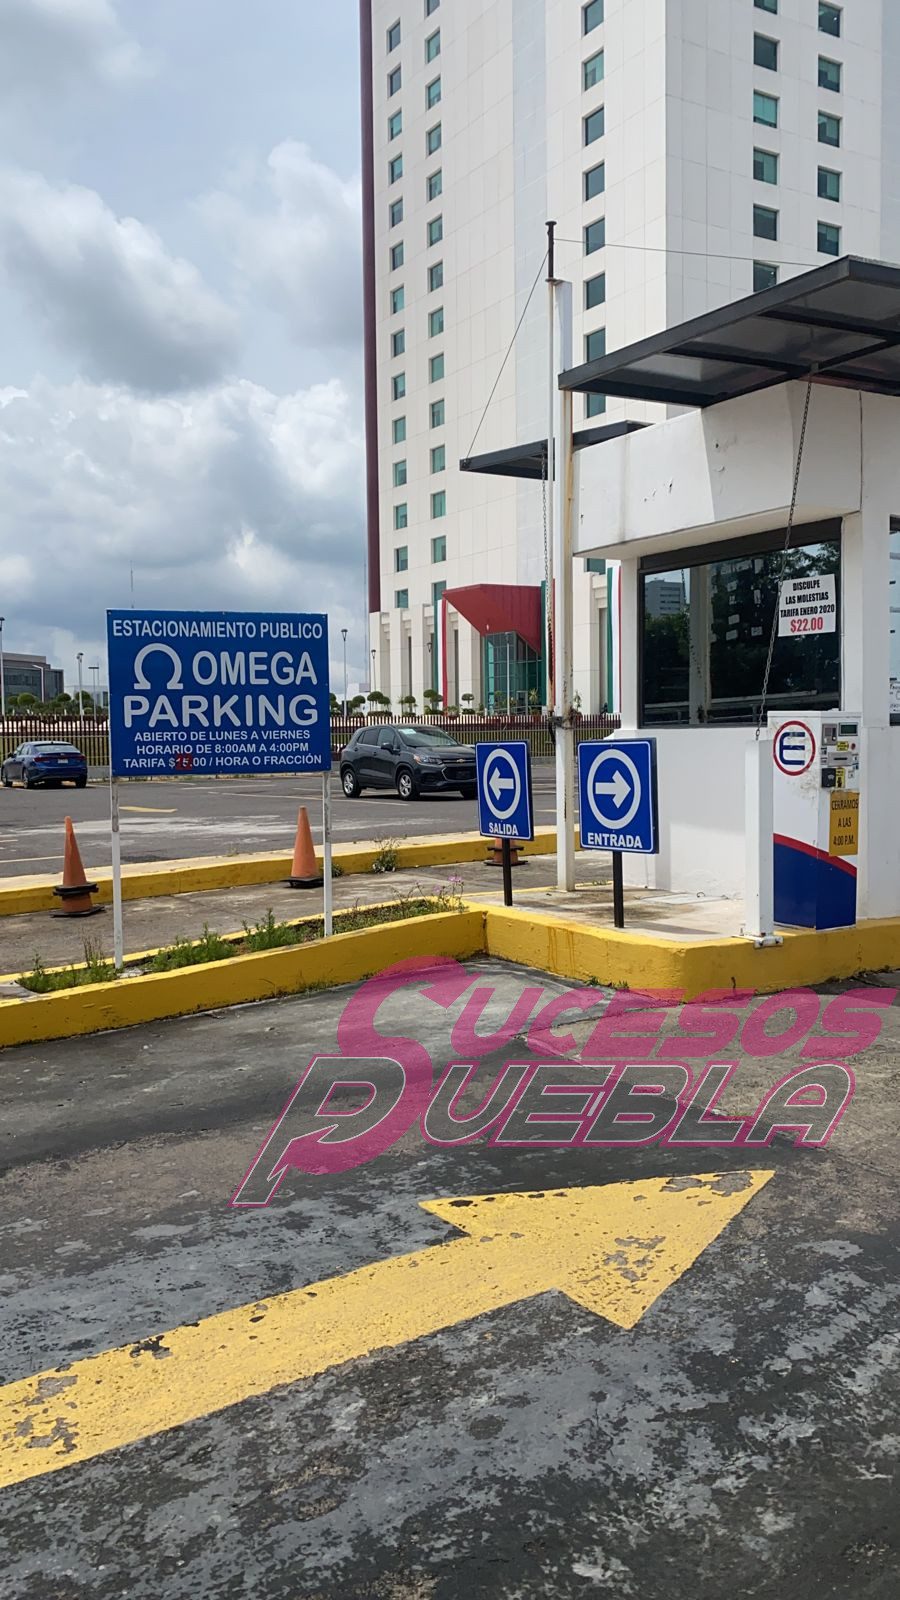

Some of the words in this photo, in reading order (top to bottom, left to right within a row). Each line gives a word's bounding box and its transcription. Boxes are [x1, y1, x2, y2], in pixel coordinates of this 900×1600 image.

[793, 580, 820, 591] DISCULPE
[785, 596, 796, 605] LAS
[797, 592, 829, 603] MOLESTIAS
[780, 608, 800, 618] TARIFA
[800, 606, 818, 616] ENERO
[819, 604, 835, 614] 2020
[113, 620, 257, 638] ESTACIONAMIENTO
[260, 623, 323, 639] PUBLICO
[790, 617, 824, 633] $22.00
[192, 651, 318, 686] OMEGA
[123, 694, 319, 728] PARKING
[134, 731, 187, 742] ABIERTO
[190, 731, 206, 741] DE
[209, 730, 248, 741] LUNES
[250, 730, 259, 740] A
[262, 729, 311, 740] VIERNES
[136, 744, 193, 755] HORARIO
[195, 744, 212, 754] DE
[214, 743, 257, 753] 8:00AM
[258, 743, 267, 753] A
[269, 742, 309, 752] 4:00PM
[123, 757, 166, 768] TARIFA
[215, 756, 250, 767] HORA
[252, 756, 261, 766] O
[263, 753, 322, 765] FRACCIÓN
[831, 799, 859, 810] CERRAMOS
[488, 822, 519, 836] SALIDA
[837, 818, 843, 828] A
[843, 817, 852, 828] LAS
[587, 832, 643, 849] ENTRADA
[833, 835, 844, 846] 4:00
